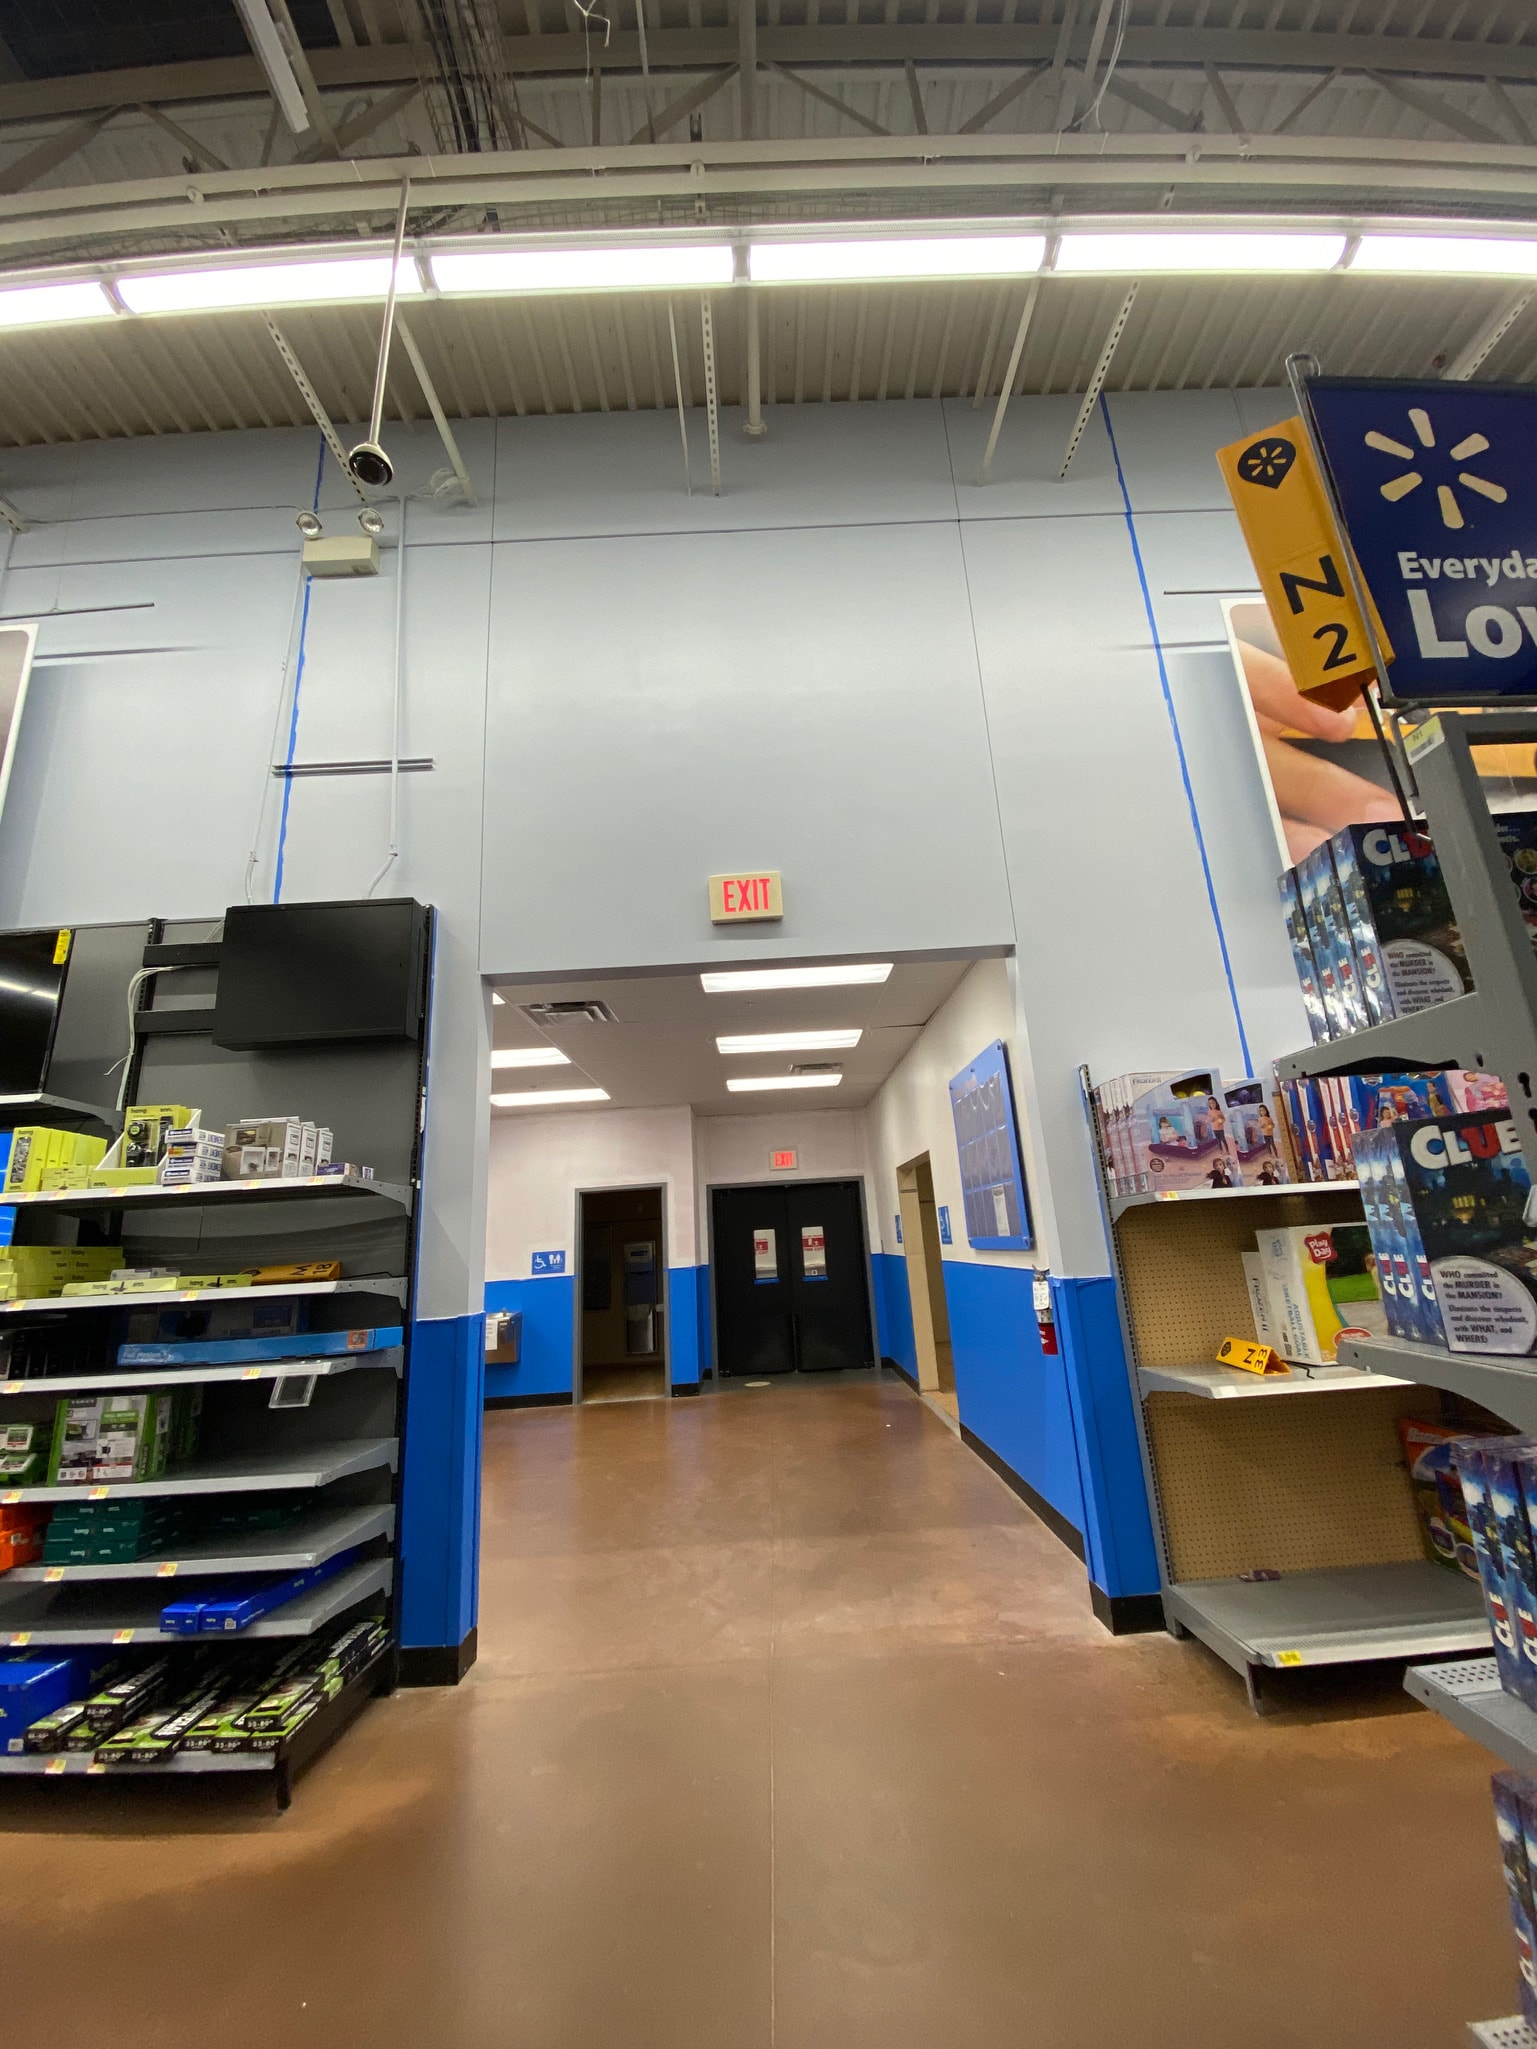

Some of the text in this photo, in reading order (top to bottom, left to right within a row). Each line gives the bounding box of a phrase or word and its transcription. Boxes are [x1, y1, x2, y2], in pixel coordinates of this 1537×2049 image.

[1406, 588, 1537, 660] Lo
[1313, 622, 1357, 671] 2
[722, 878, 771, 913] EXIT
[774, 1152, 793, 1167] EXIT
[1410, 1119, 1522, 1170] CLUE
[1308, 1239, 1329, 1250] Play
[1314, 1247, 1332, 1258] Day
[1378, 1252, 1397, 1296] CLUE
[1393, 1254, 1414, 1298] CLUE
[1416, 1254, 1436, 1300] CLUE
[1440, 1270, 1460, 1278] WHO
[1455, 1280, 1491, 1288] MURDER
[1458, 1291, 1502, 1299] MANSION?
[1292, 1303, 1310, 1360] ADJUSTABLE
[1243, 1348, 1268, 1370] N 33
[1489, 1592, 1514, 1648] CLUE
